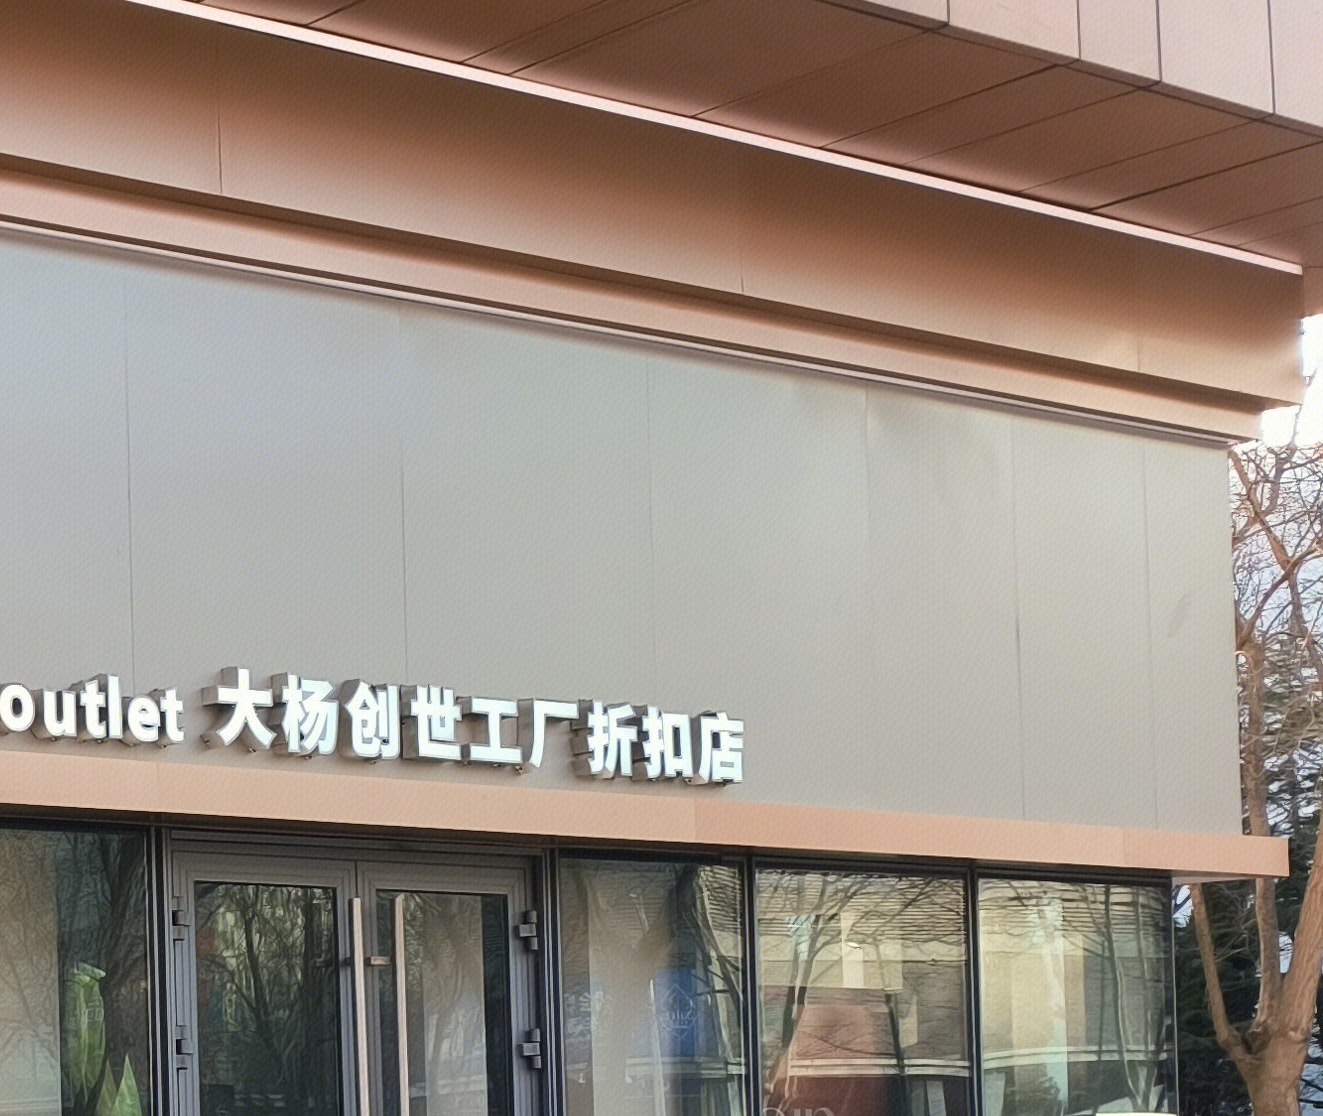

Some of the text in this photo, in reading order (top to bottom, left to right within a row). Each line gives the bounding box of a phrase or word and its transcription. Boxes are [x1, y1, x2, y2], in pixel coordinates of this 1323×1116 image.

[211, 666, 746, 786] 大杨创世工厂折扣店
